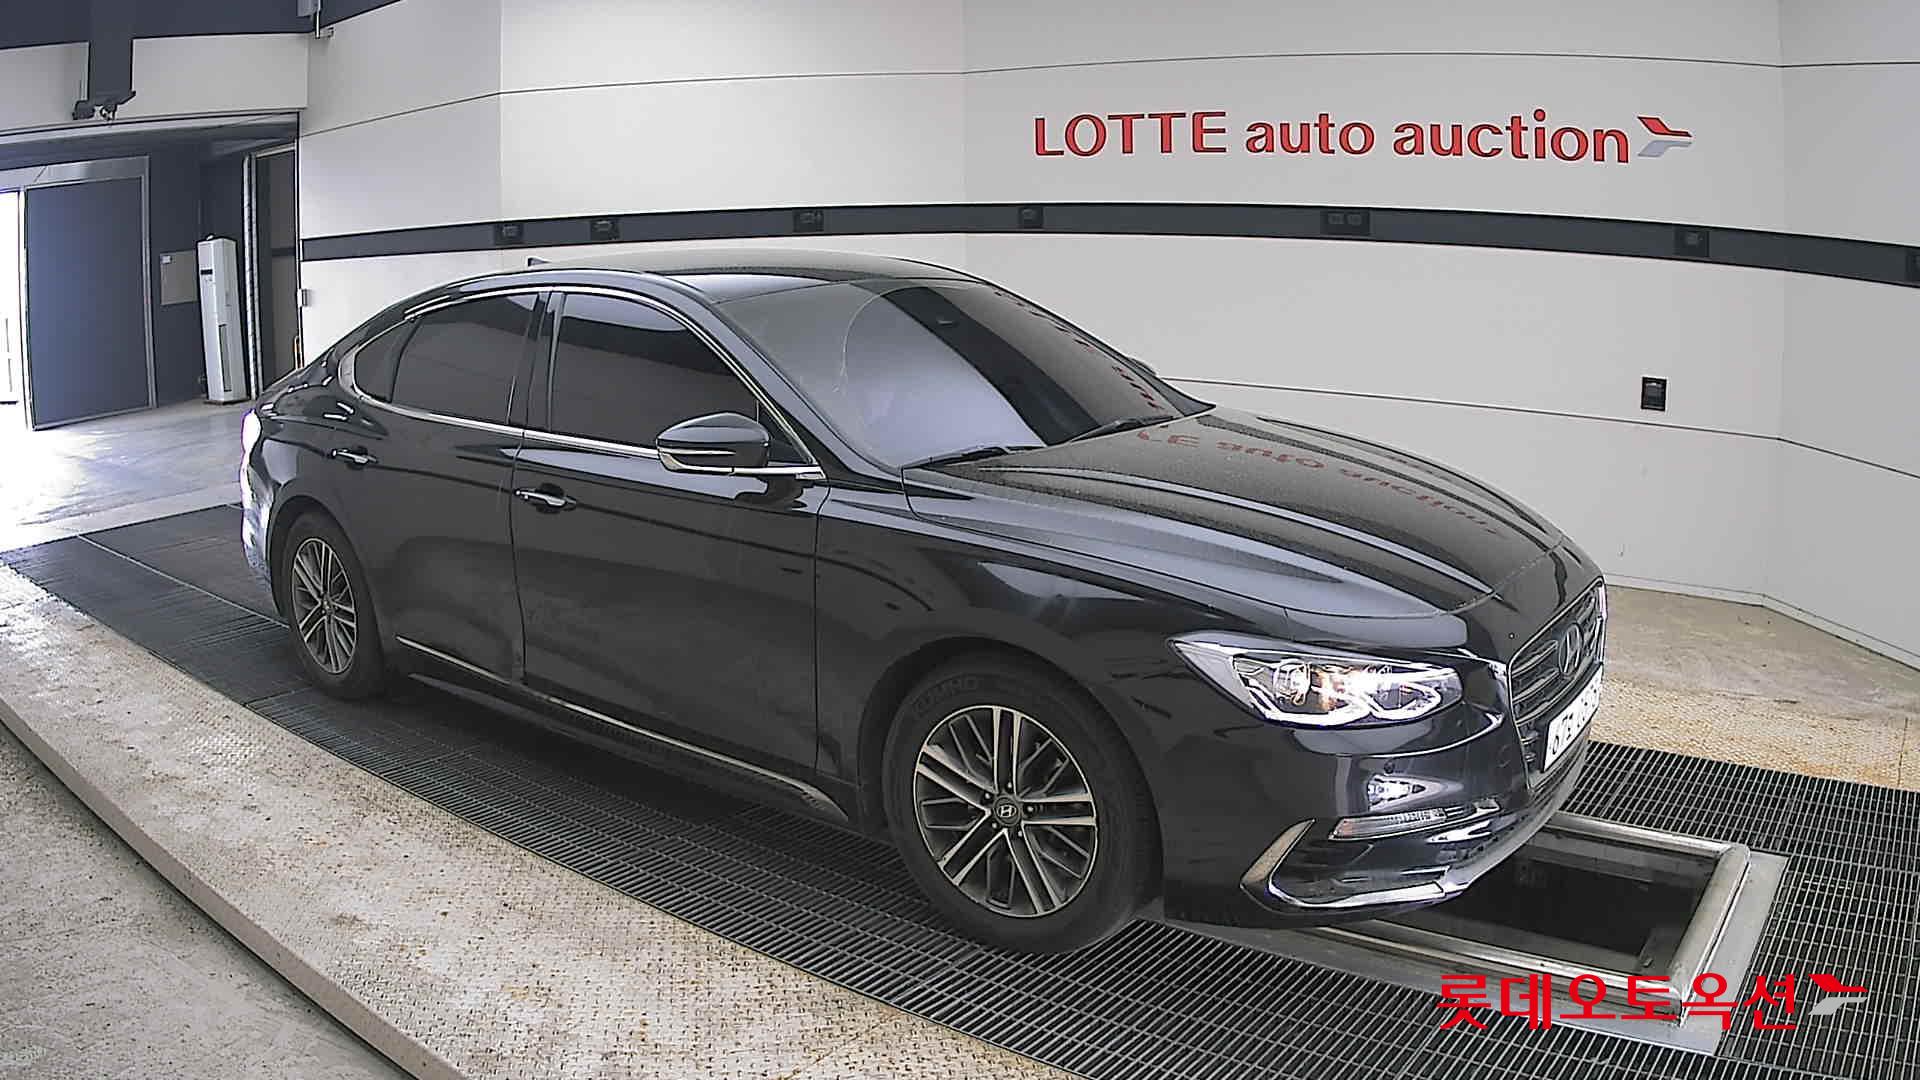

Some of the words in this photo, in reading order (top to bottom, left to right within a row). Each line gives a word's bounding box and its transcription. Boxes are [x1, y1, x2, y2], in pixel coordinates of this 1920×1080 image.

[1034, 111, 1227, 156] LOTTE
[1245, 113, 1375, 154] auto
[1392, 109, 1629, 163] auction
